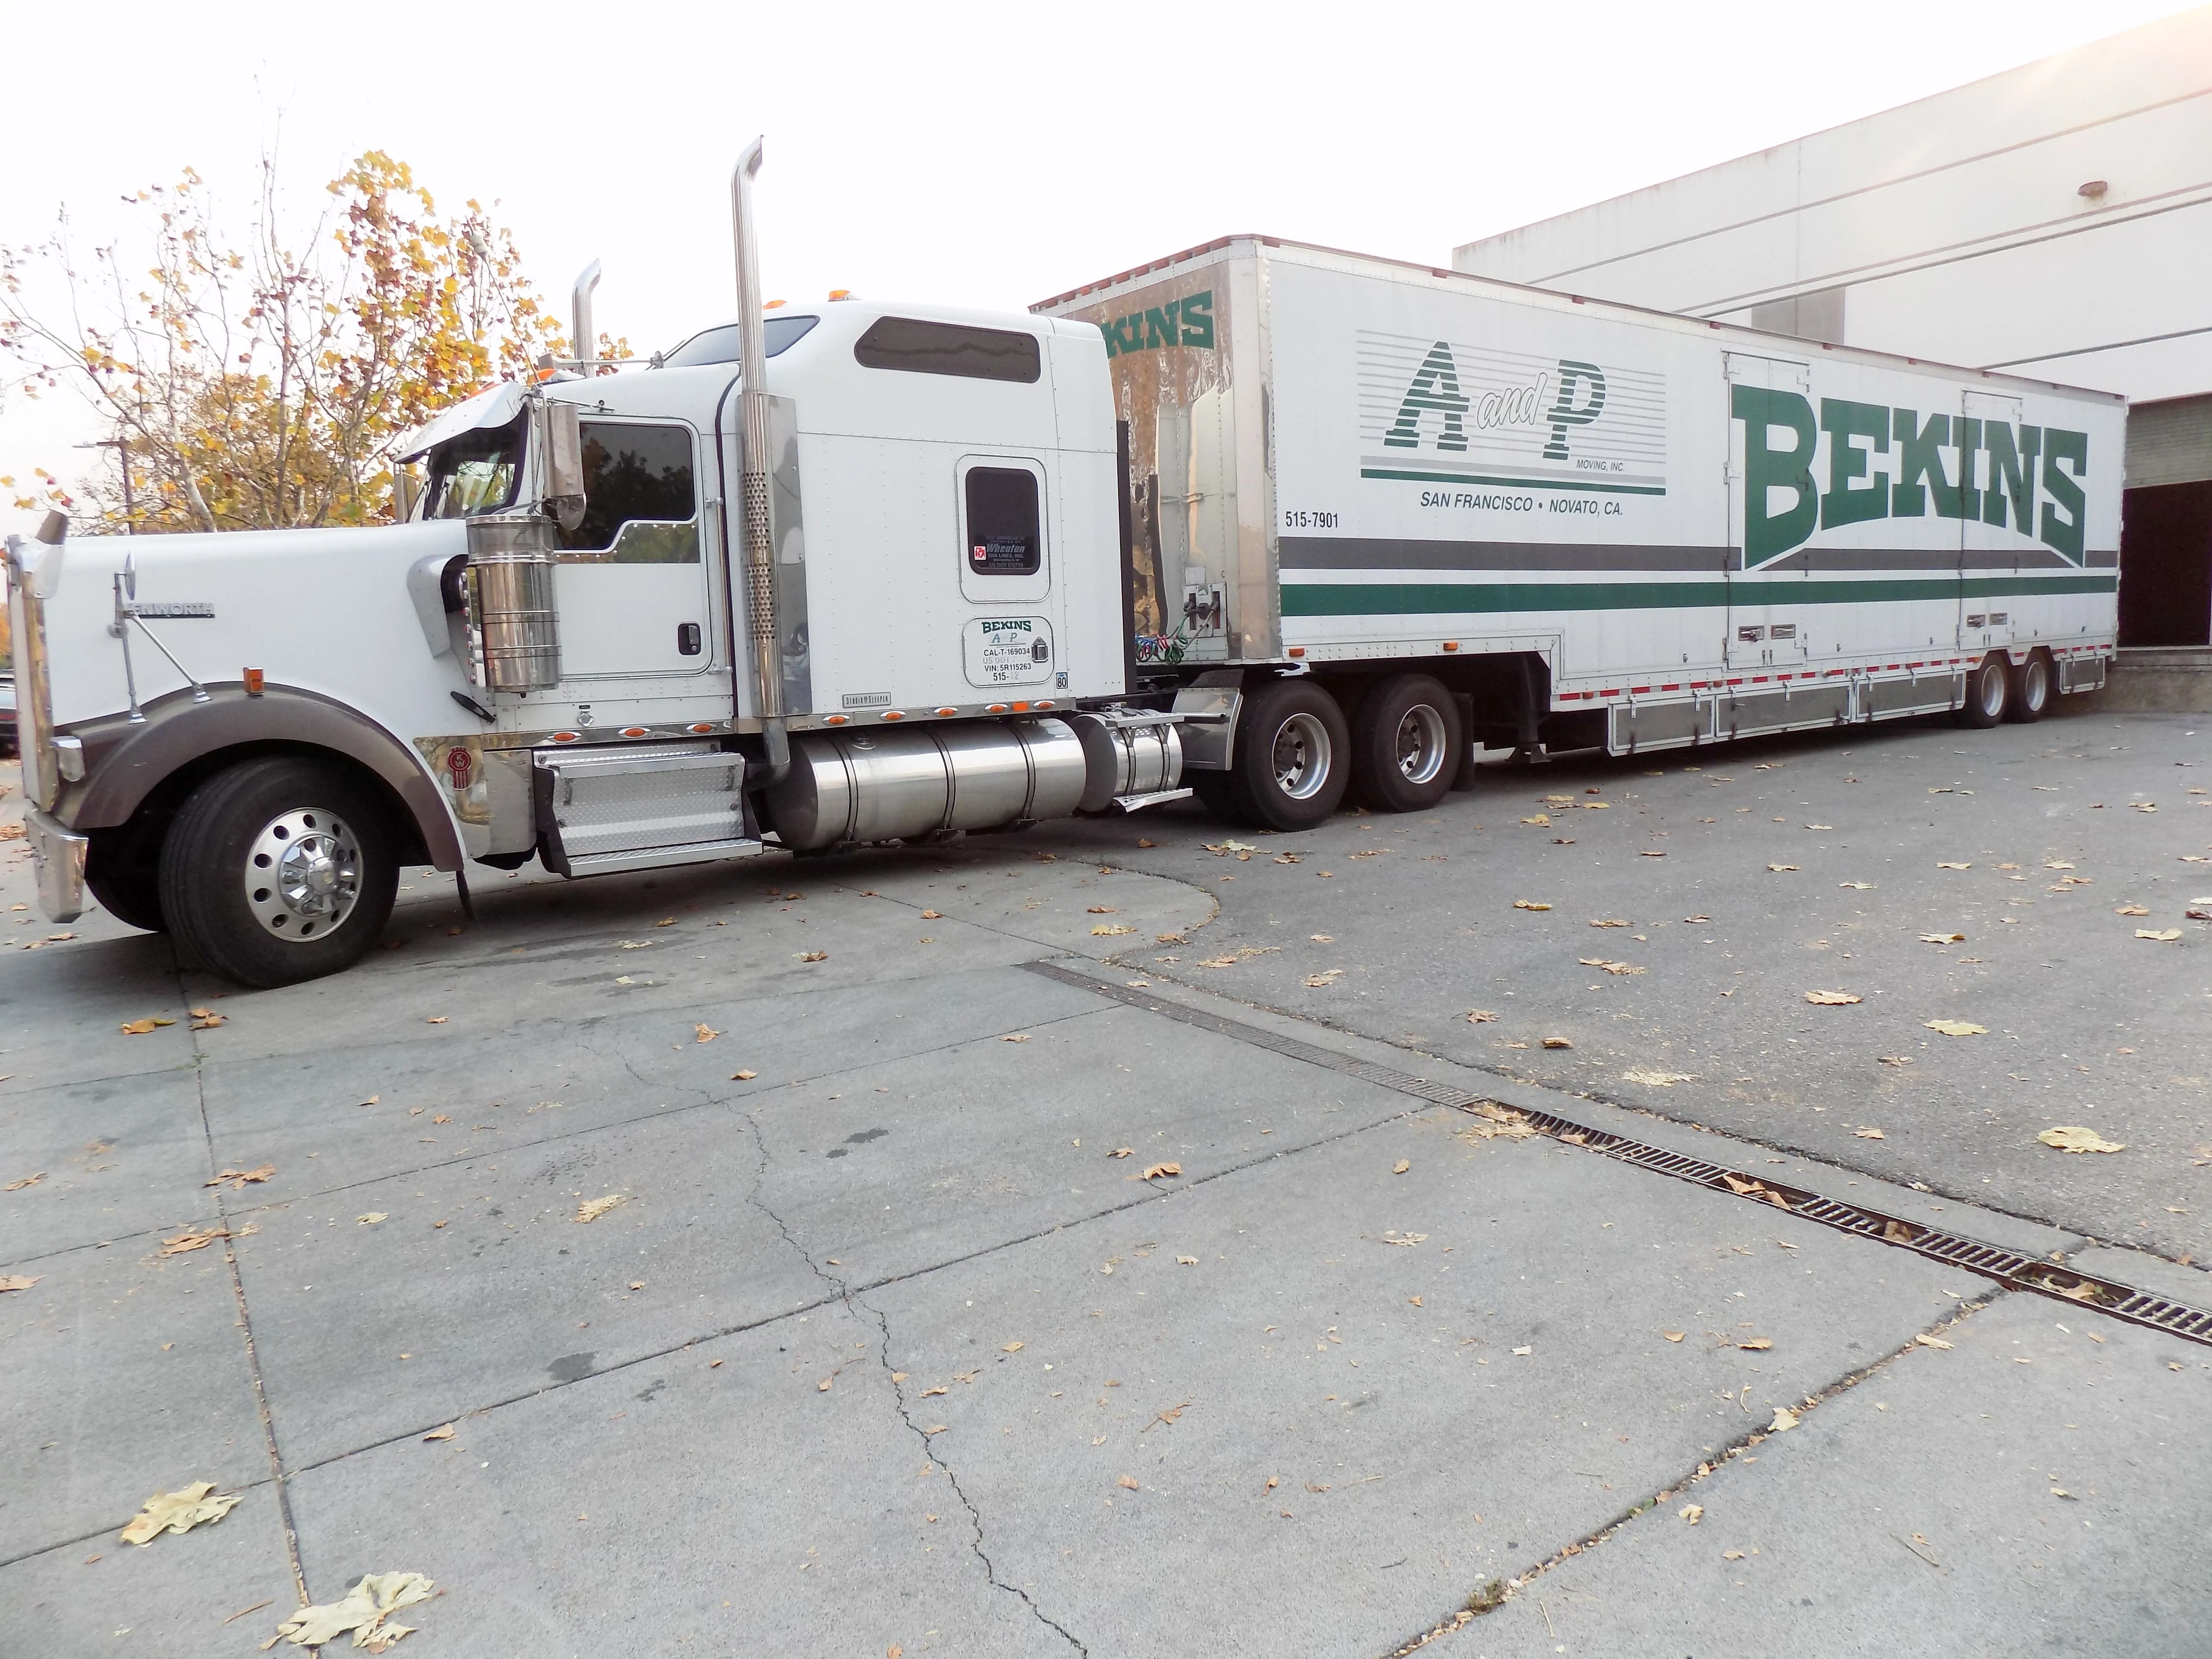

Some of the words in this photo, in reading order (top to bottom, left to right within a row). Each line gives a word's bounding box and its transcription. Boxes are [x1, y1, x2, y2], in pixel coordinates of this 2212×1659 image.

[1383, 341, 1470, 451] A
[1477, 372, 1548, 429] and
[1542, 359, 1606, 460] P
[1577, 459, 1608, 472] MOVING,
[1610, 462, 1625, 471] INC.
[1731, 383, 2087, 570] BEKINS
[1420, 491, 1451, 507] SAN
[1454, 493, 1533, 512] FRANCISCO
[1549, 499, 1601, 517] NOVATO,
[1604, 501, 1623, 515] CA.
[1285, 511, 1338, 530] 515-7901
[987, 543, 1025, 553] Wheaton
[981, 620, 1032, 634] BEKINS
[991, 633, 1000, 643] A
[1009, 632, 1017, 642] P
[984, 648, 1030, 656] CAL-T-169034
[1000, 663, 1031, 671] 5R115263
[1057, 677, 1066, 687] 80
